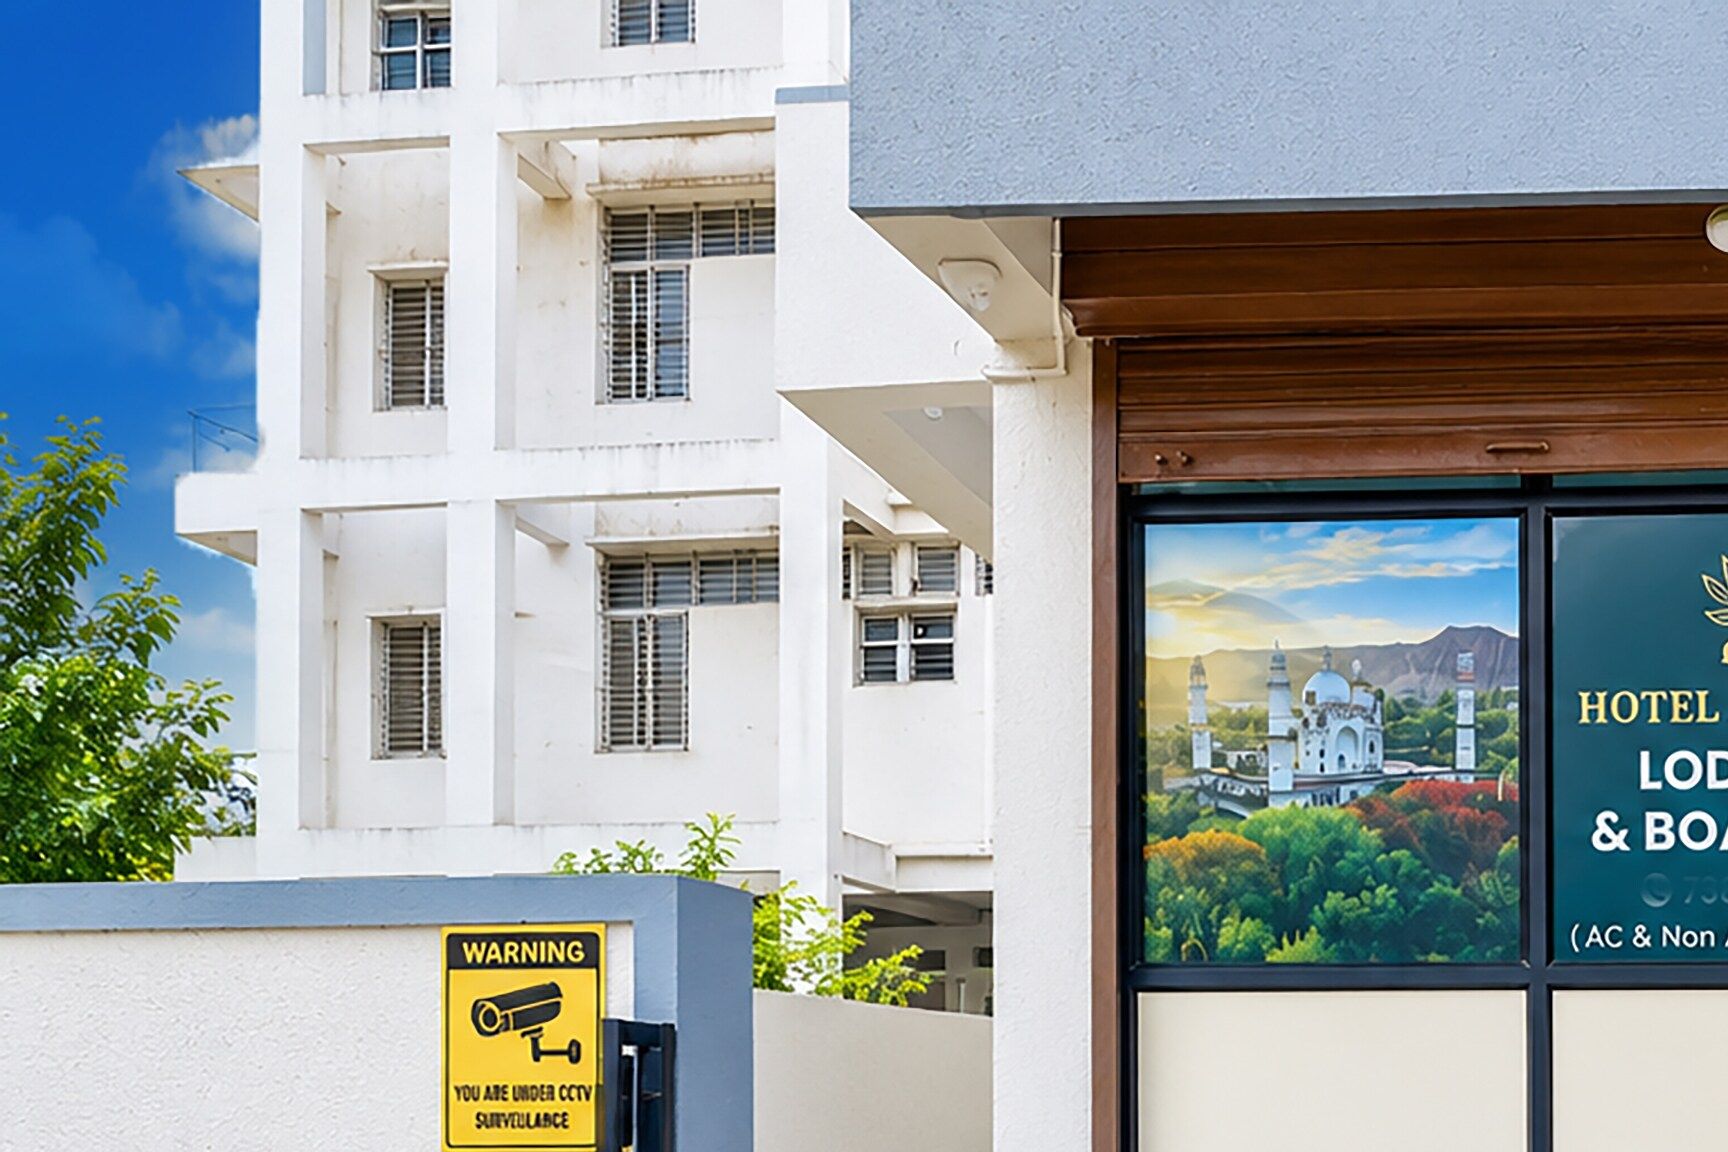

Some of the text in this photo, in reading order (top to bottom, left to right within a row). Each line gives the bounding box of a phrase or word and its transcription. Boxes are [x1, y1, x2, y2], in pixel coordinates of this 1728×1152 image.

[1577, 689, 1721, 725] HOTEL
[1590, 809, 1632, 853] &
[1631, 923, 1654, 949] &
[1661, 923, 1717, 949] Non
[461, 939, 586, 965] WARNING
[454, 1084, 593, 1102] YOU ARE UNDER CCTV
